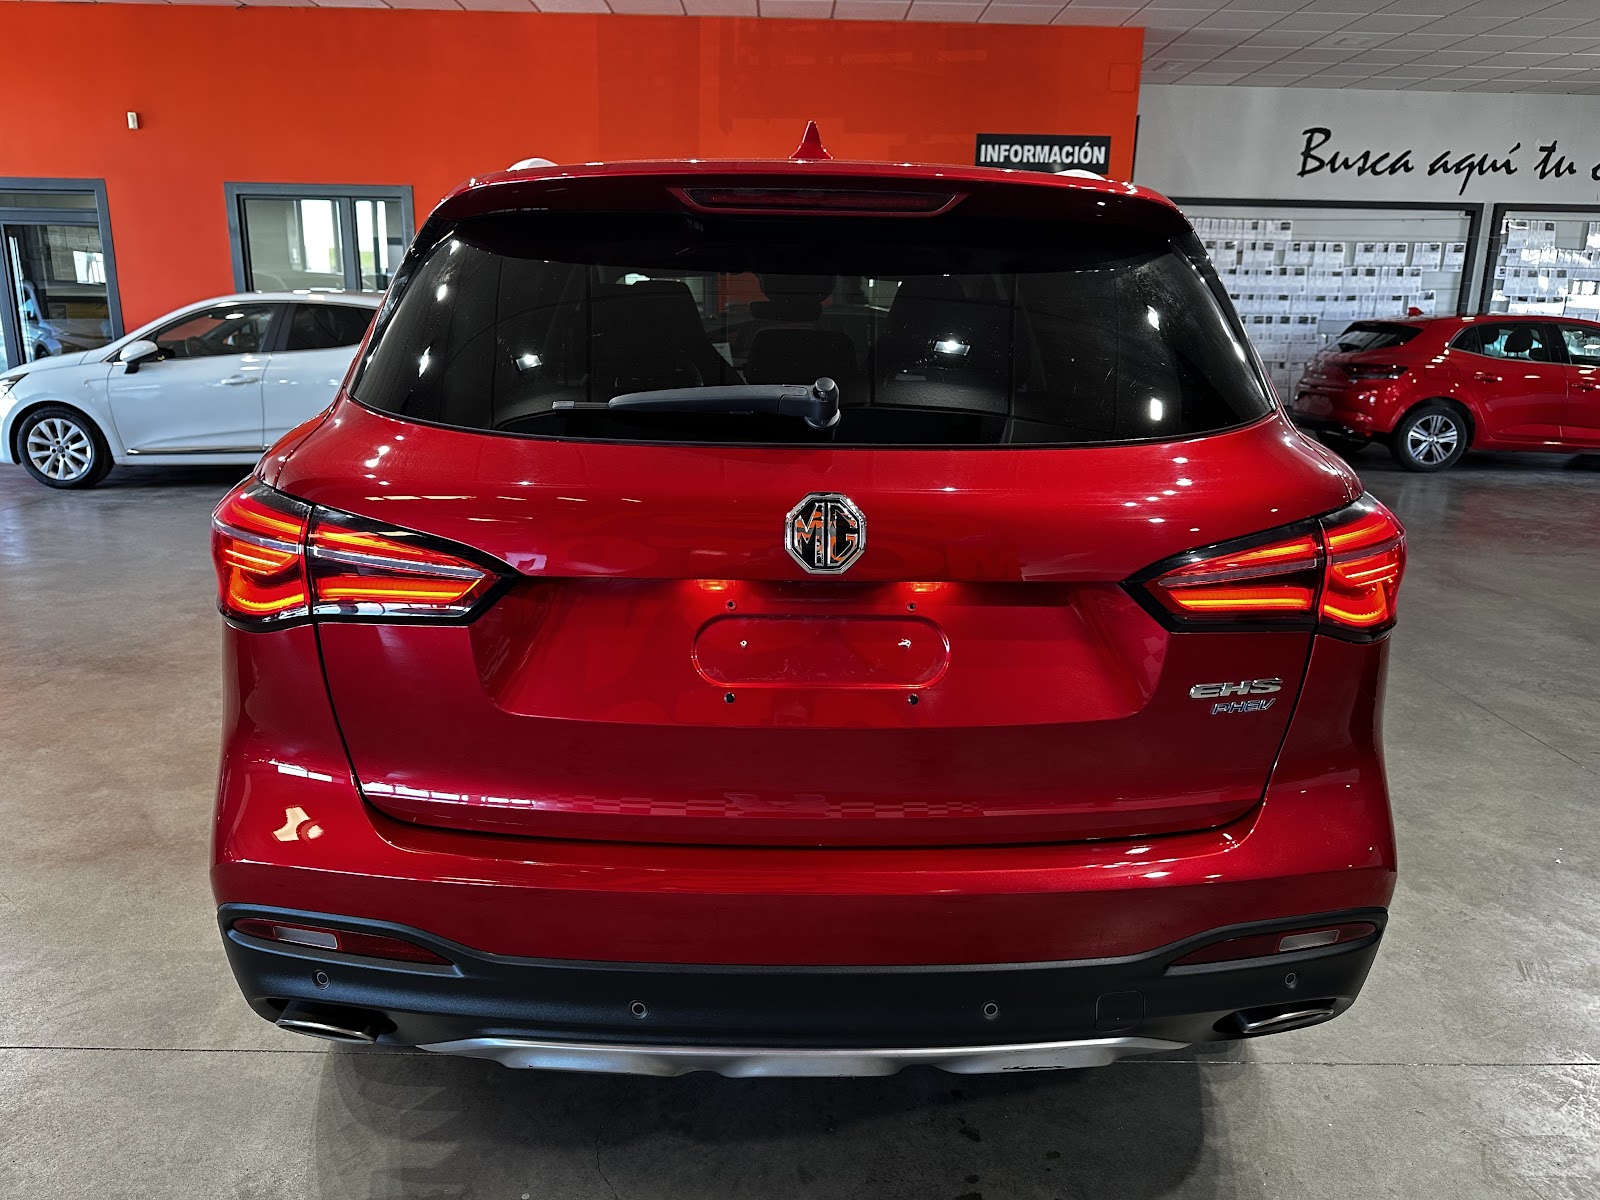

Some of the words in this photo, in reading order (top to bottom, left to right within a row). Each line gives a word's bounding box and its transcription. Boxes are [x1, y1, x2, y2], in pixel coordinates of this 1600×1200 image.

[980, 141, 1106, 164] INFORMACIÓN
[1297, 127, 1414, 178] Busca
[1427, 142, 1521, 196] aquí
[1534, 140, 1577, 180] tu
[793, 501, 859, 567] MG
[1189, 677, 1283, 698] EHS
[1211, 698, 1276, 715] PHEV
